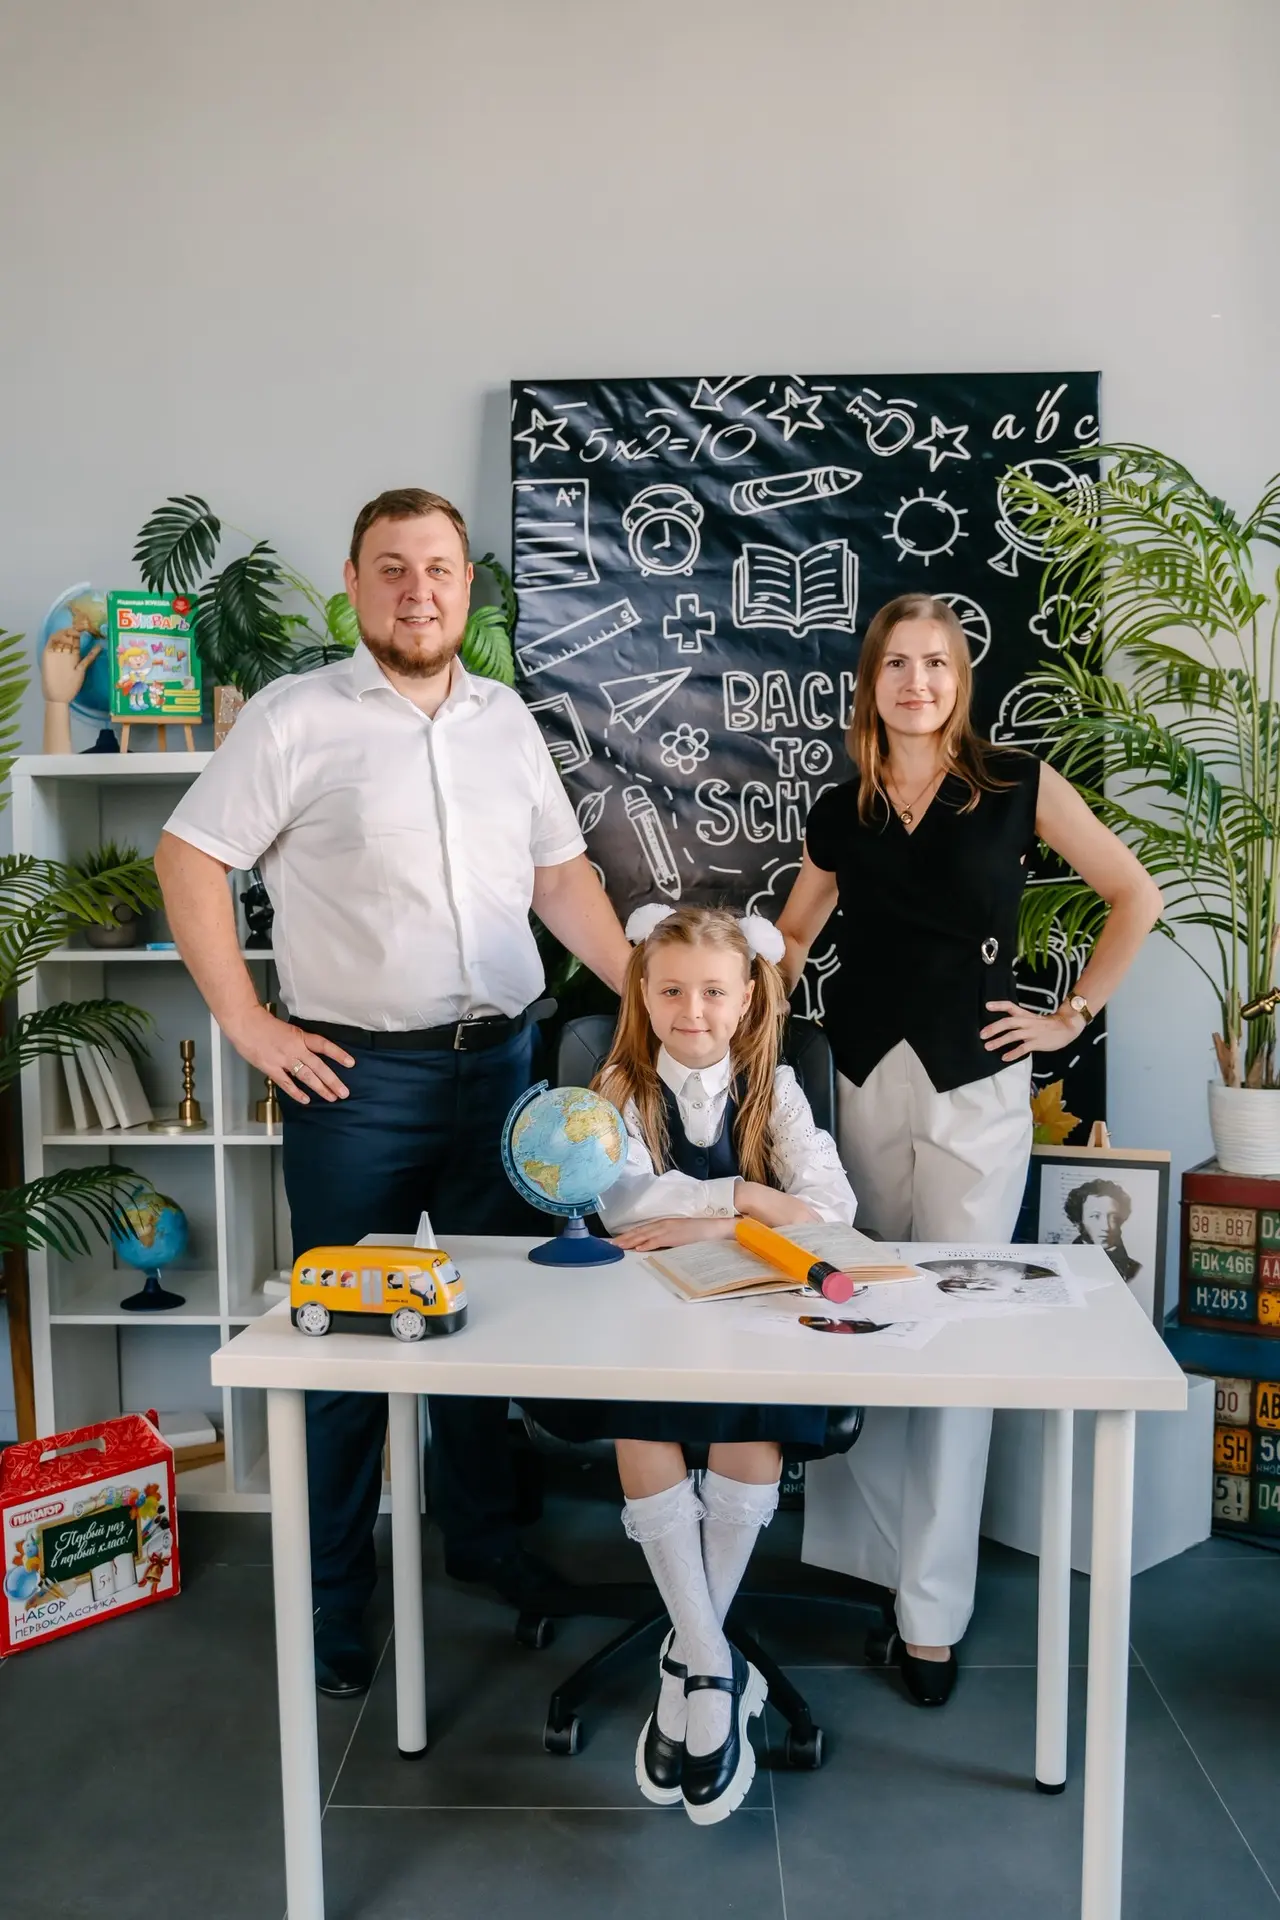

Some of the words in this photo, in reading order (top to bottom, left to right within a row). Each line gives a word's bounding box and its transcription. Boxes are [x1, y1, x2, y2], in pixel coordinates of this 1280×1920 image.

[556, 487, 581, 507] A+
[771, 737, 833, 777] TO
[695, 778, 838, 846] SCH
[1191, 1215, 1209, 1234] 38
[1225, 1218, 1253, 1238] 887
[106, 1521, 126, 1538] раз
[14, 1600, 67, 1627] НАБОР
[15, 1597, 118, 1640] ПЕРВОКЛАССНИКА
